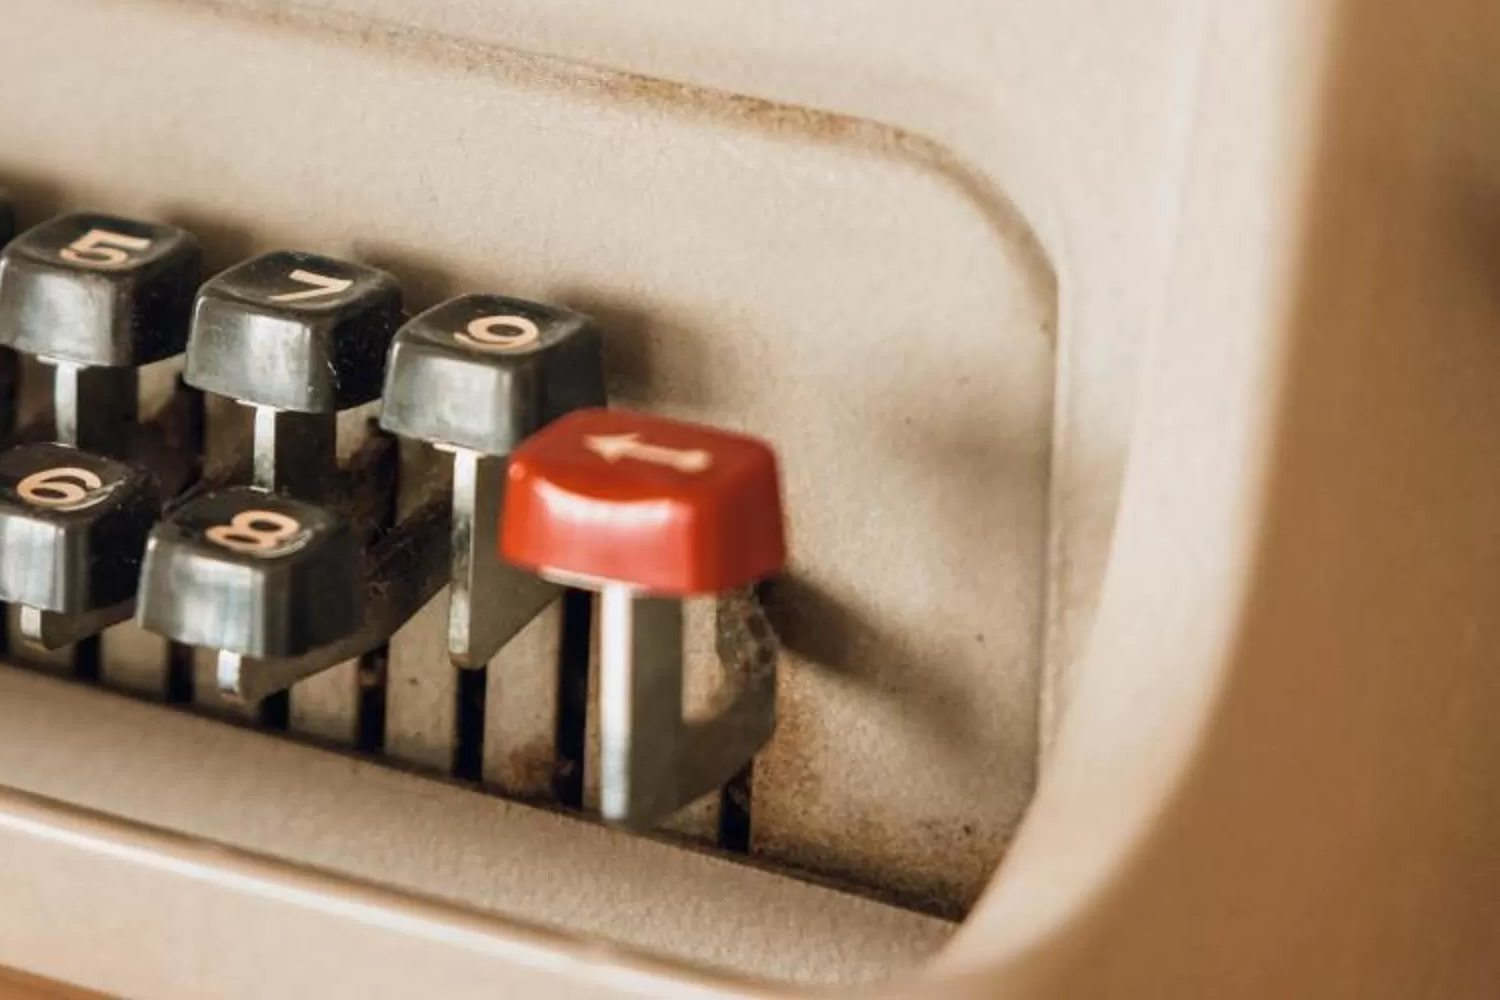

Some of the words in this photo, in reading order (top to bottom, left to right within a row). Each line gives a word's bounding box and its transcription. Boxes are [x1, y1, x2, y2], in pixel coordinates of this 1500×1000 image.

[59, 229, 151, 270] 5
[268, 269, 355, 301] 7
[453, 315, 540, 351] 9
[17, 467, 102, 508] 6
[205, 509, 300, 552] 8
